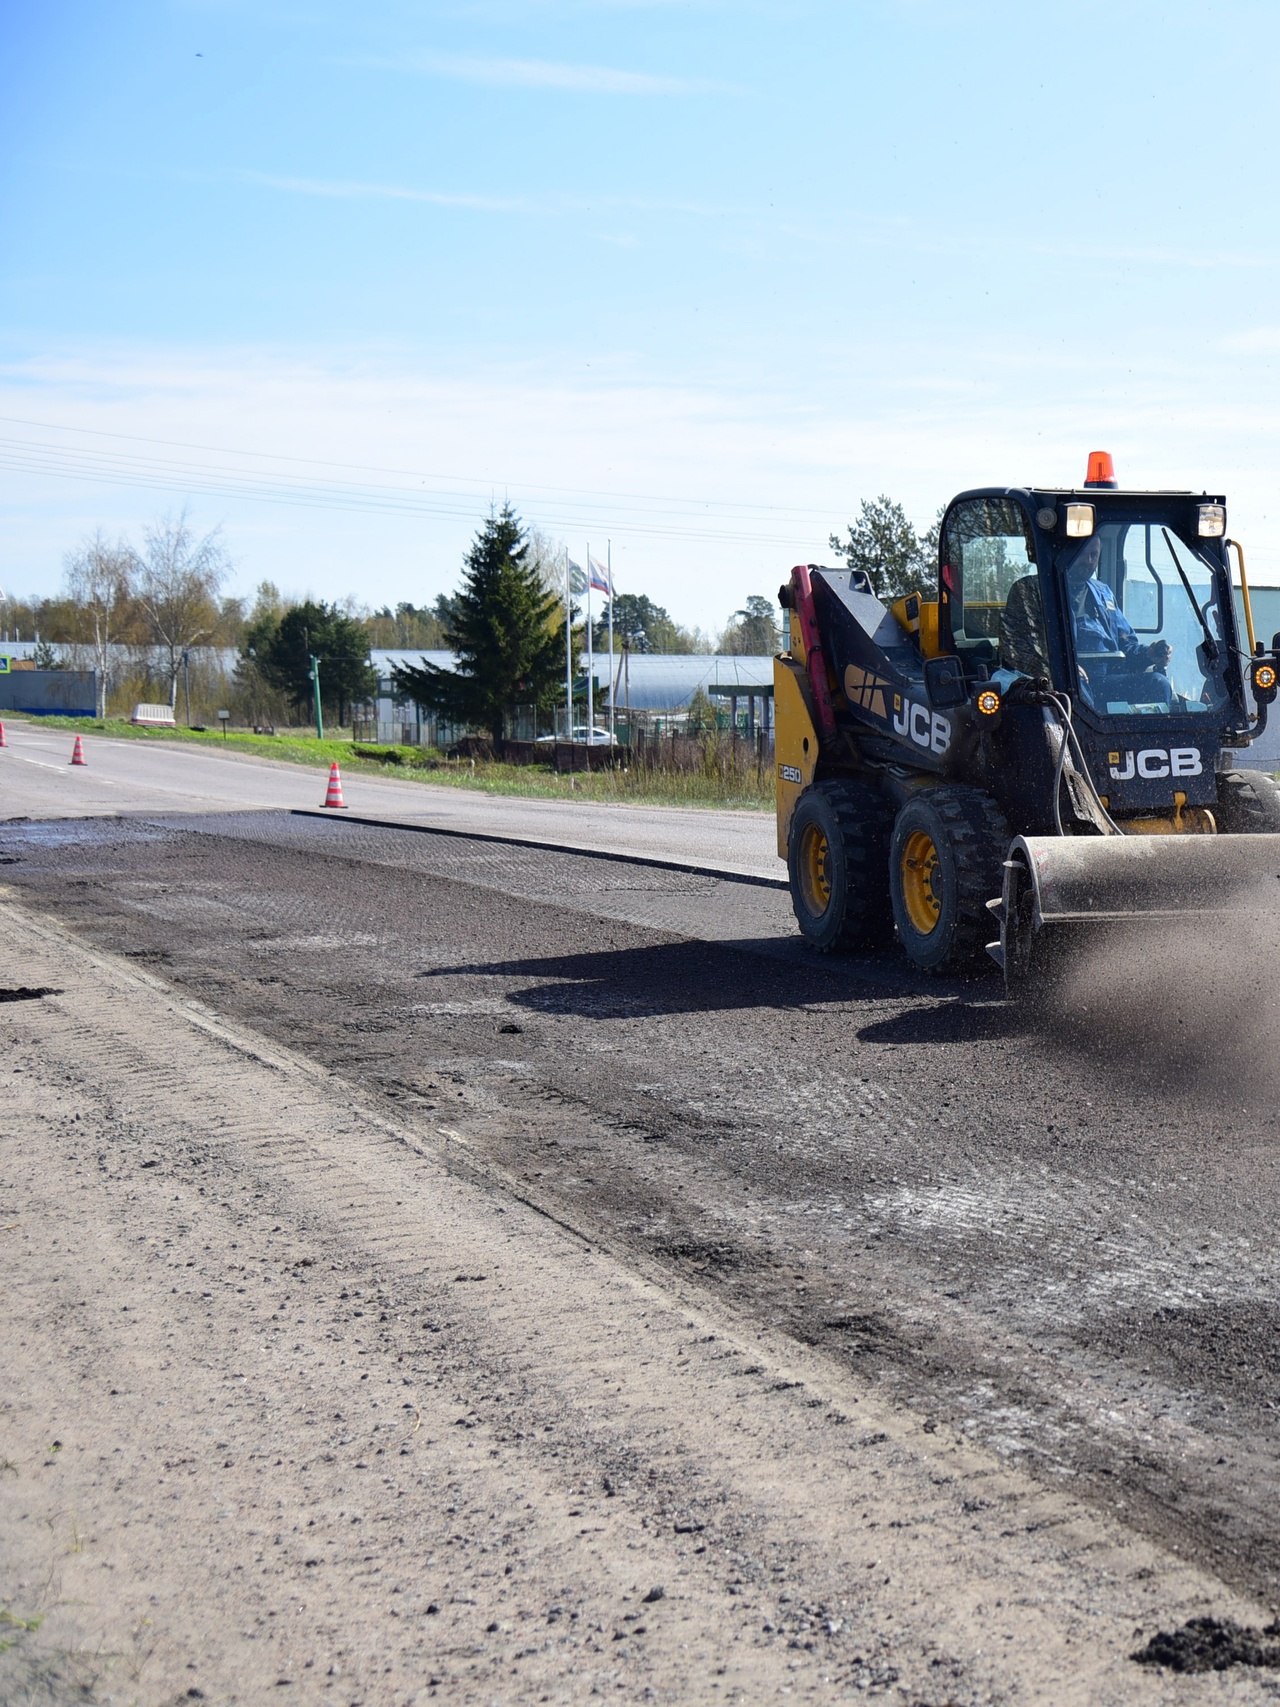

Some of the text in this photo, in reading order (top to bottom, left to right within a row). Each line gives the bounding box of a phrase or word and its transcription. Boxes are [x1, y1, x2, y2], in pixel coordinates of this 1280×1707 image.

[894, 698, 951, 755] JCB
[783, 765, 801, 783] 250
[1109, 748, 1203, 780] JCB
